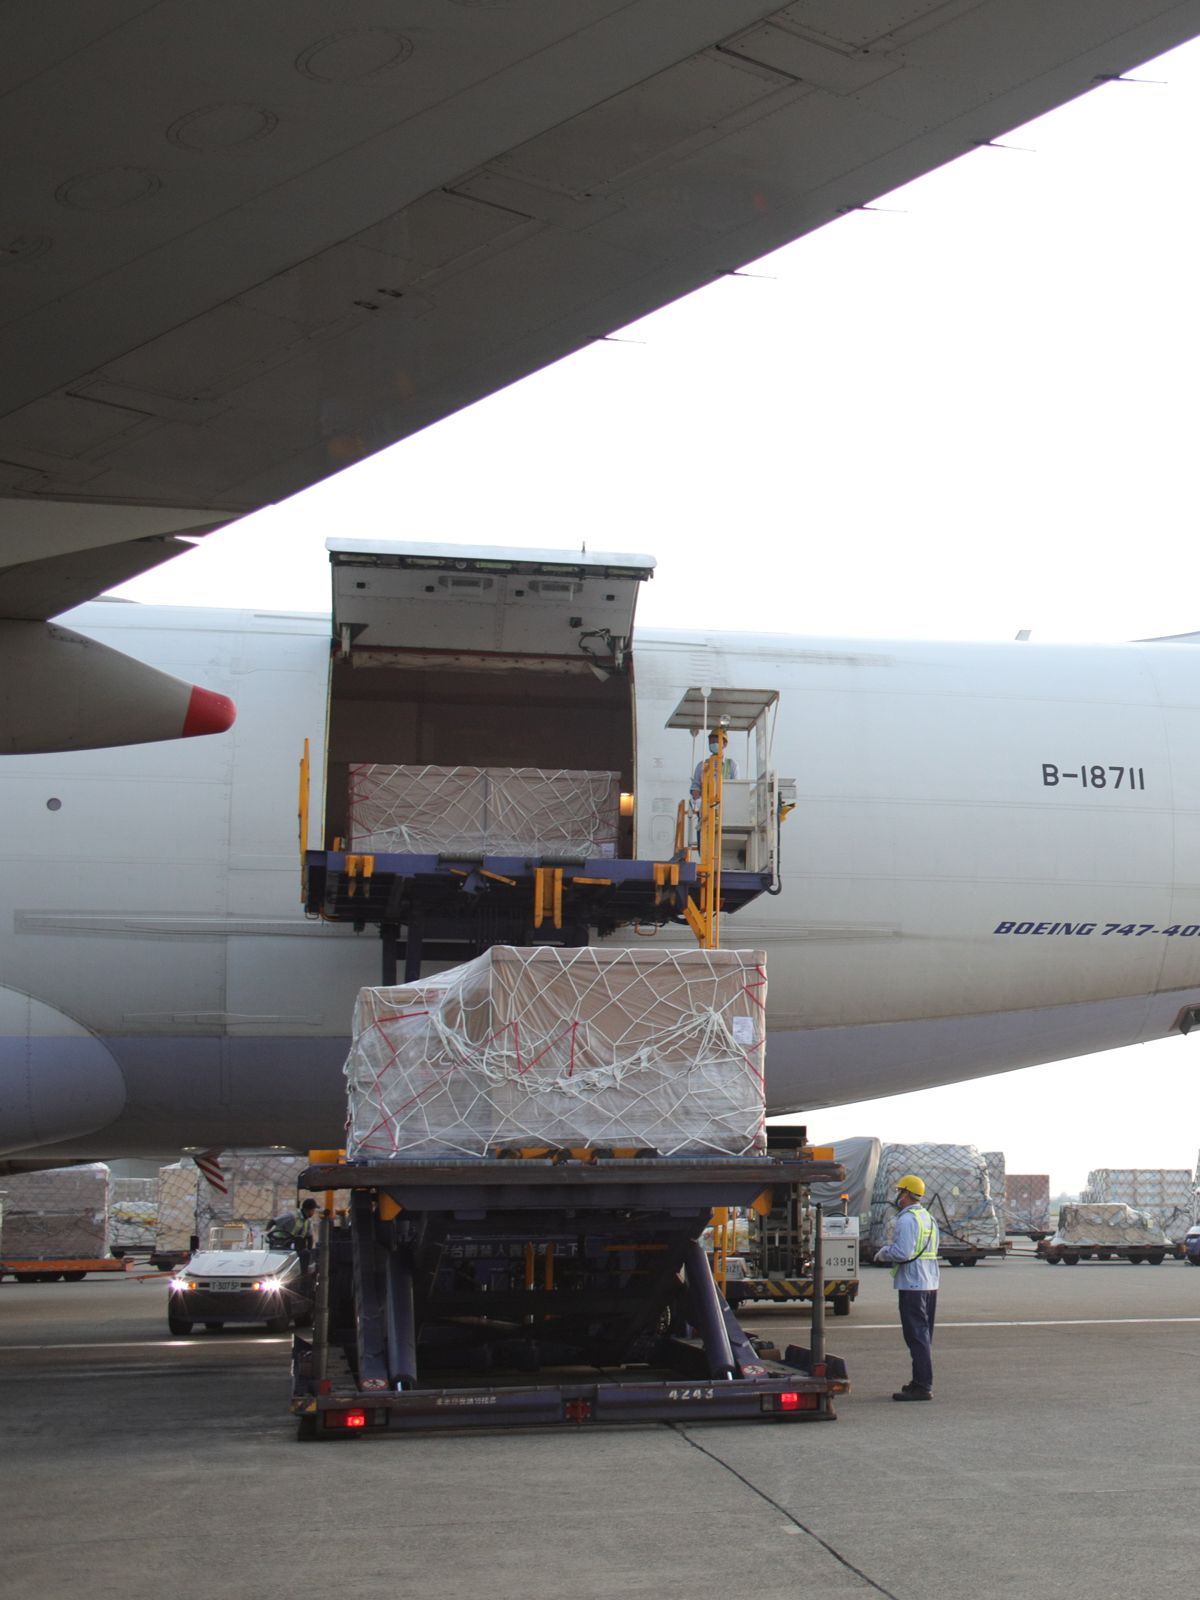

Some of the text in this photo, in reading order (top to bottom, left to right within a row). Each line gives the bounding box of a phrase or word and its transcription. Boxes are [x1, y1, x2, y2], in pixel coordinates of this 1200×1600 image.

[1041, 763, 1145, 790] B-18711
[994, 921, 1097, 936] BOEING
[825, 1257, 854, 1267] 4399
[668, 1388, 714, 1400] 4243
